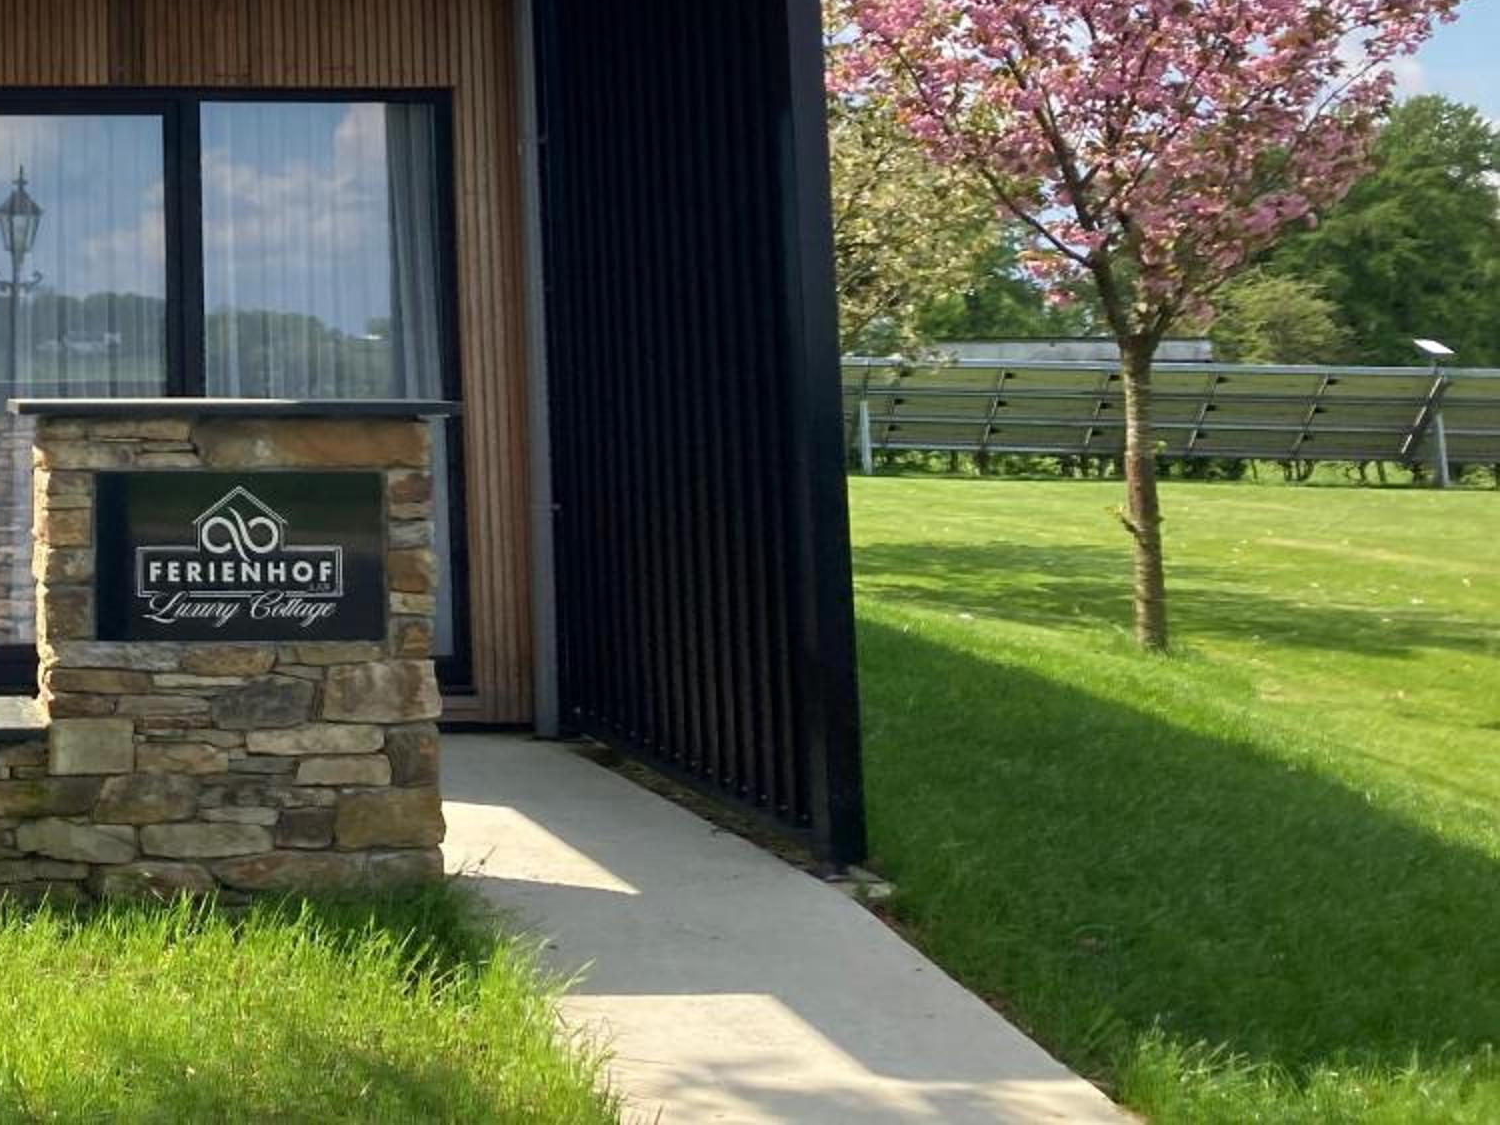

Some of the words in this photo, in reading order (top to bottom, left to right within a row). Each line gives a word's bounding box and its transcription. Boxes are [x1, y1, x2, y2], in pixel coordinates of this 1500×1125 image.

[149, 561, 332, 582] FERIENHOF
[142, 591, 239, 627] Luxury
[250, 590, 336, 627] Cottage
